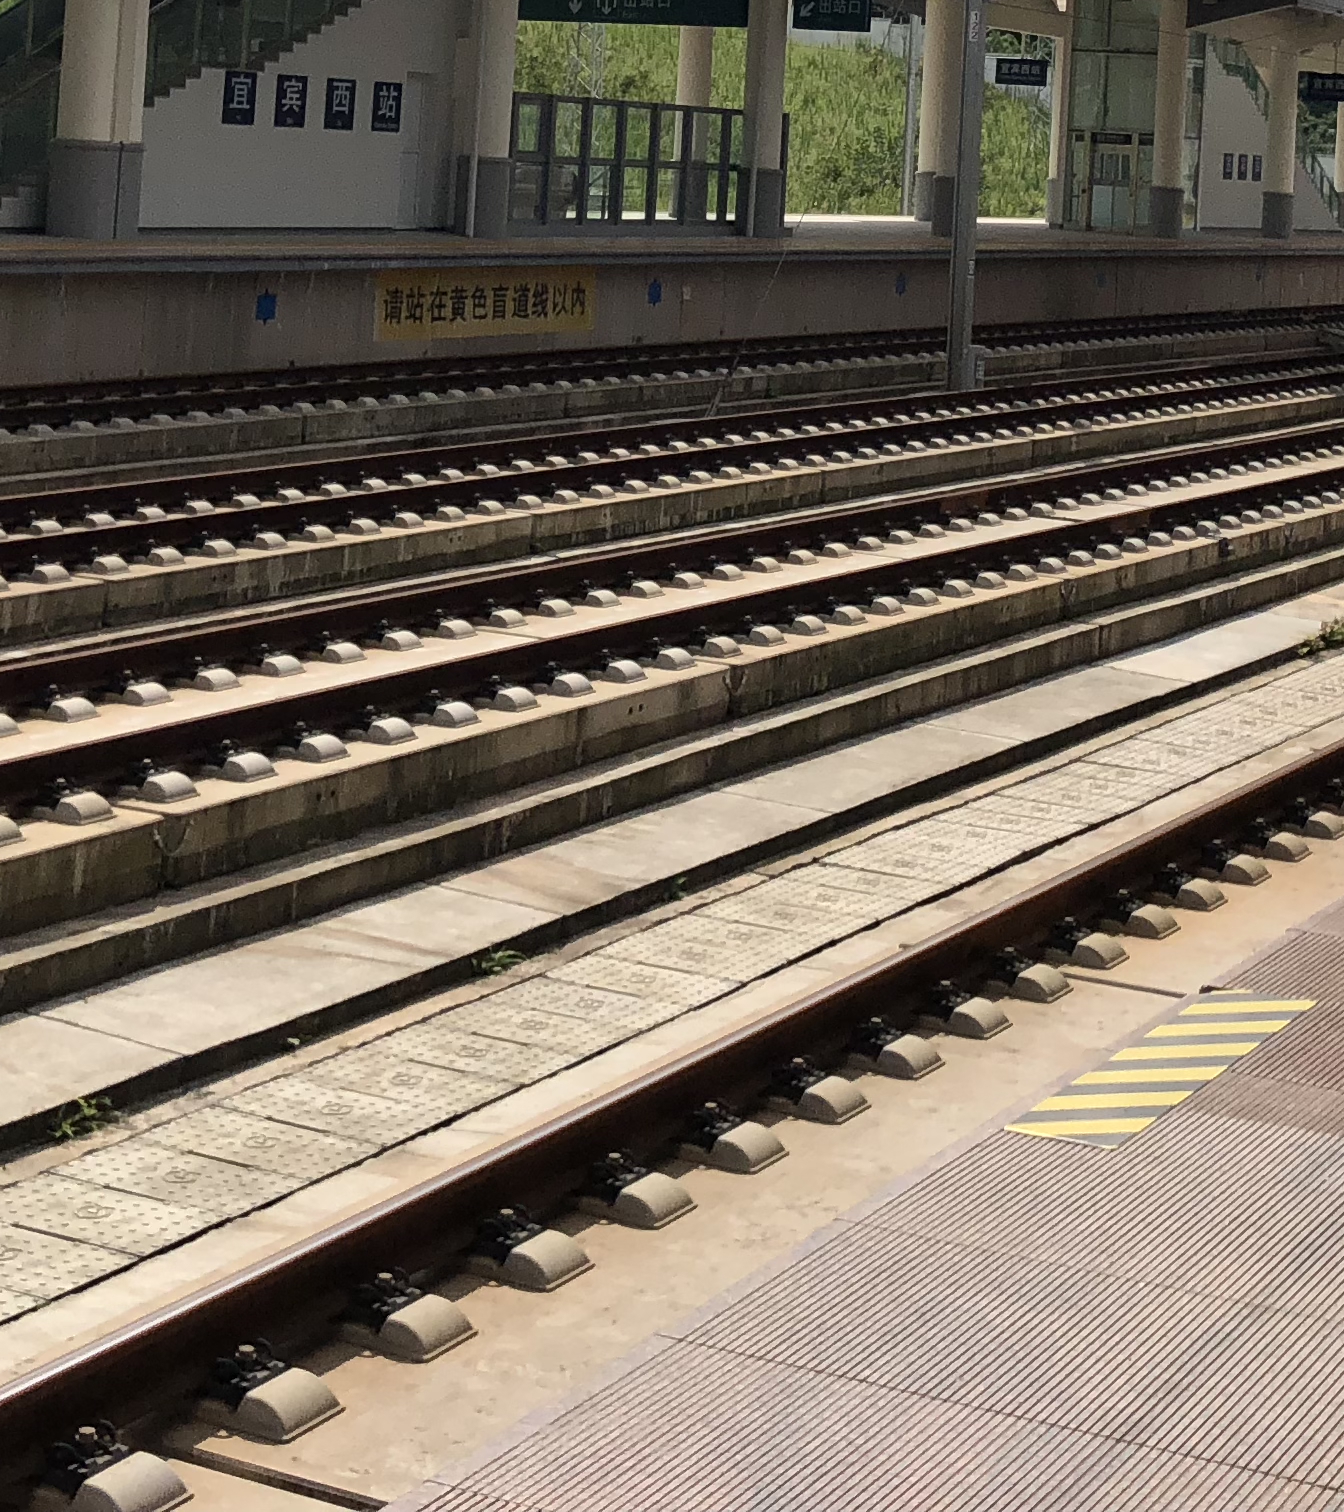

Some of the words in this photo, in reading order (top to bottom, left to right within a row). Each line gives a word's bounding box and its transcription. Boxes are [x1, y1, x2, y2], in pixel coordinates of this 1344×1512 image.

[229, 74, 399, 119] 宜宾西站
[383, 281, 587, 324] 请站在黄色盲道线以内
